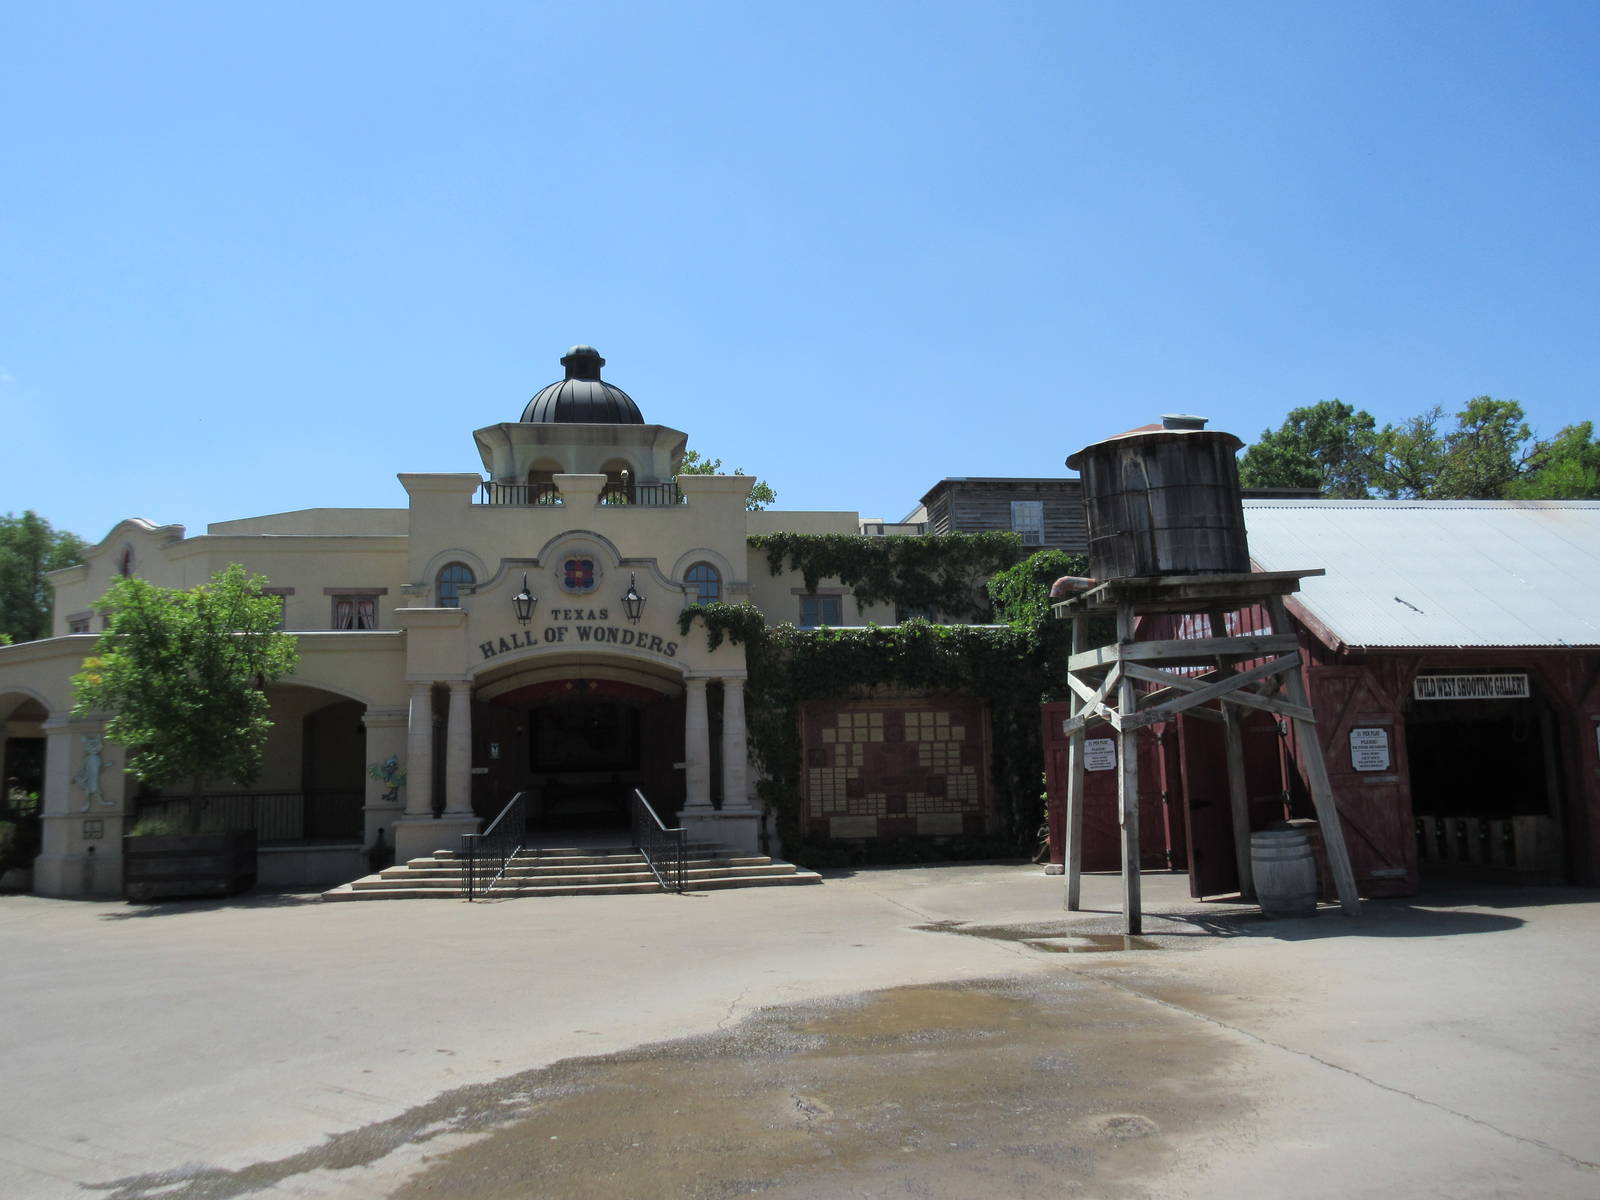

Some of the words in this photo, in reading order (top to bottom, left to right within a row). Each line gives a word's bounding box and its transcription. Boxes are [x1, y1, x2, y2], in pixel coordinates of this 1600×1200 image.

[551, 609, 609, 621] TEXAS
[479, 630, 538, 660] HALL
[544, 626, 569, 643] OF
[576, 625, 679, 658] WONDERS
[1416, 677, 1436, 697] WILD
[1436, 677, 1456, 697] WEST
[1456, 676, 1494, 697] SHOOTING
[1494, 676, 1526, 696] GALLERY
